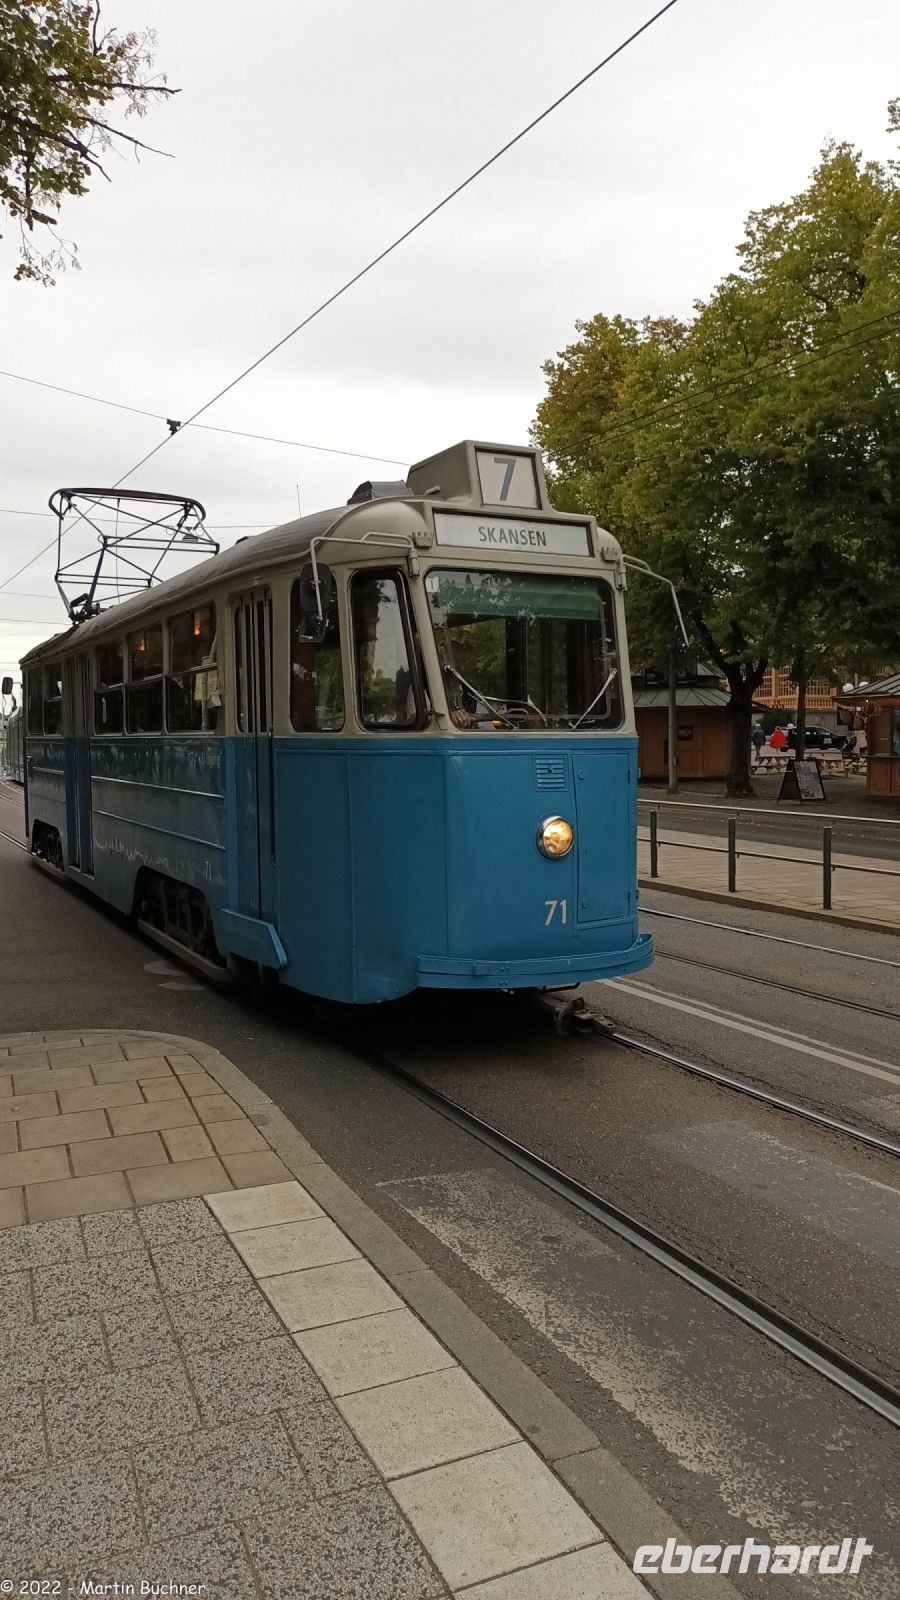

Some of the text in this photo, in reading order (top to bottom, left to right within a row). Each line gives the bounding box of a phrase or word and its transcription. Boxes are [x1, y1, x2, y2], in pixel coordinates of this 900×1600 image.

[493, 457, 516, 501] 7
[478, 526, 547, 547] SKANSEN
[544, 899, 567, 926] 71
